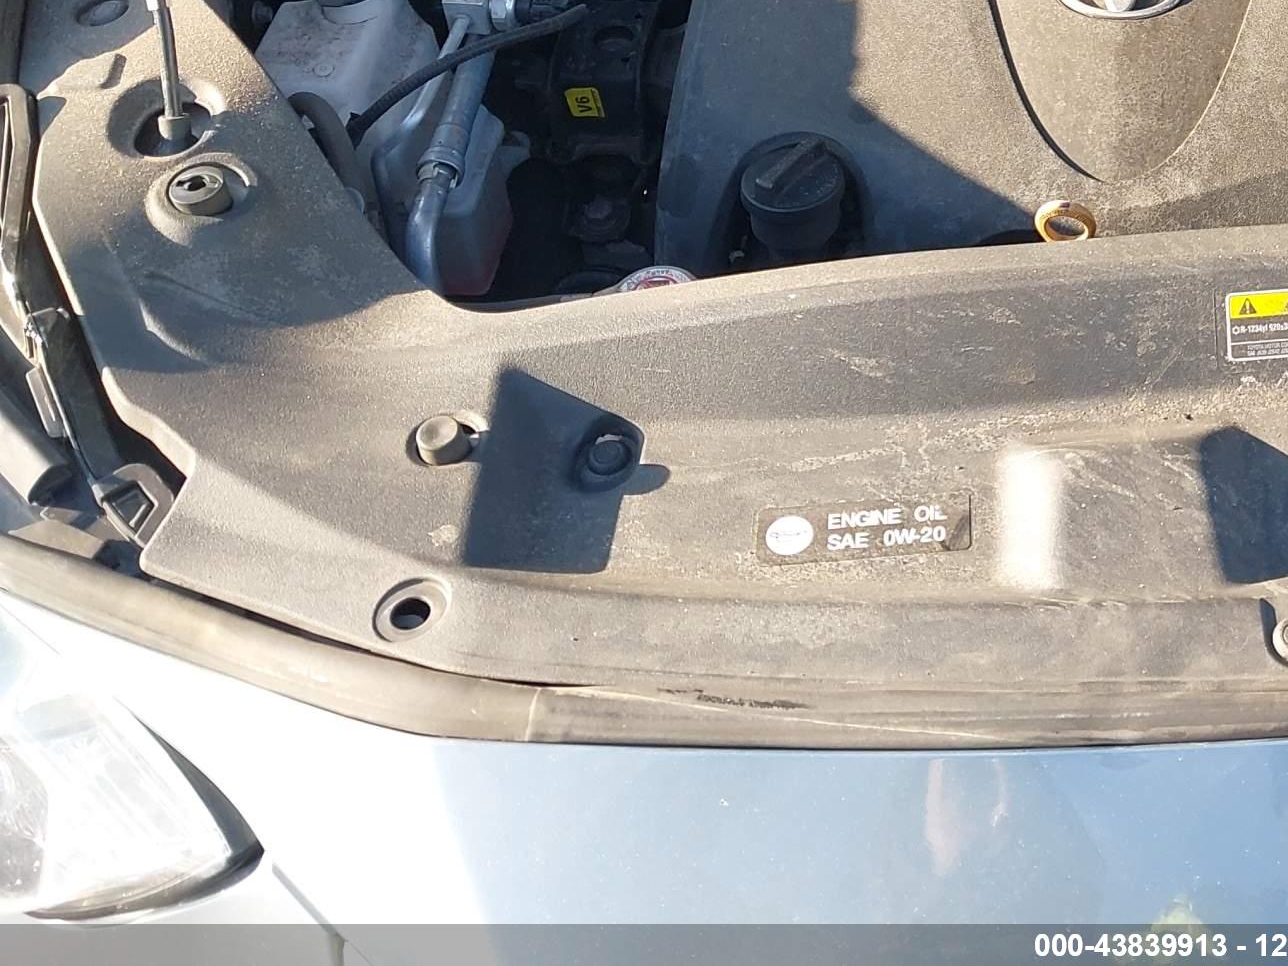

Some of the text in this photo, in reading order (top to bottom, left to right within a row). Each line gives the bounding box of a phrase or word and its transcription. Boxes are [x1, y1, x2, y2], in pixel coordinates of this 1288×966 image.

[575, 96, 593, 113] V6
[827, 505, 948, 529] ENGINE OIL
[827, 532, 869, 551] SAE
[883, 525, 947, 547] 0W-20
